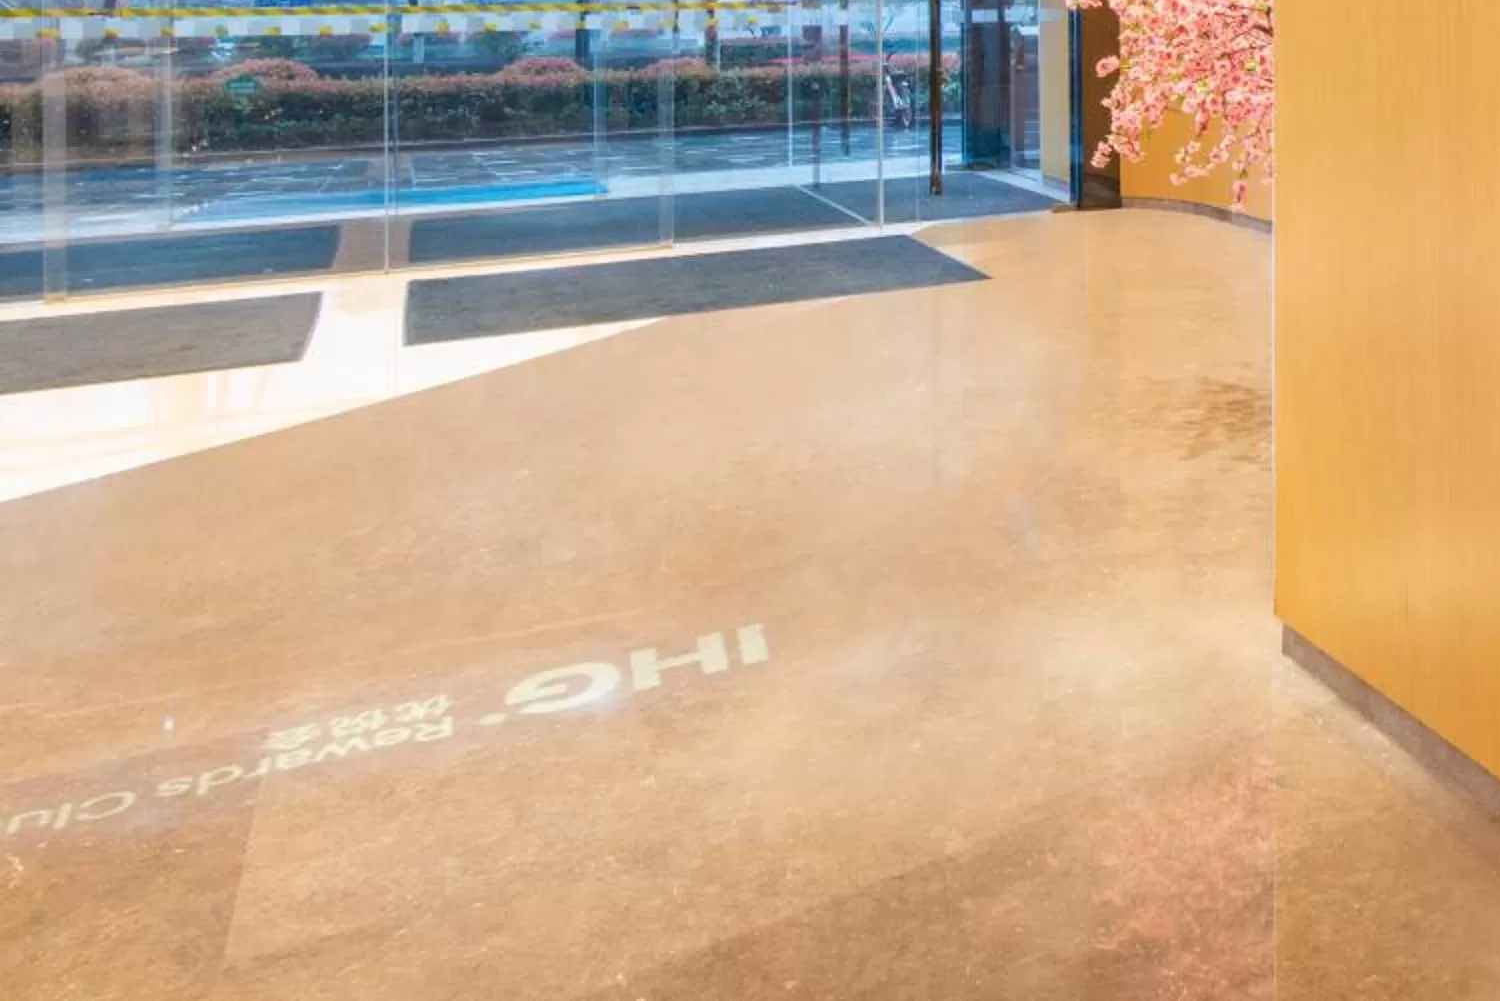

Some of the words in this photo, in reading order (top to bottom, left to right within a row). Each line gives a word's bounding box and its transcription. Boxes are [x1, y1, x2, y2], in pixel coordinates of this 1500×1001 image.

[503, 623, 769, 713] IHG
[157, 715, 455, 798] Rewards
[0, 790, 137, 835] Clu
